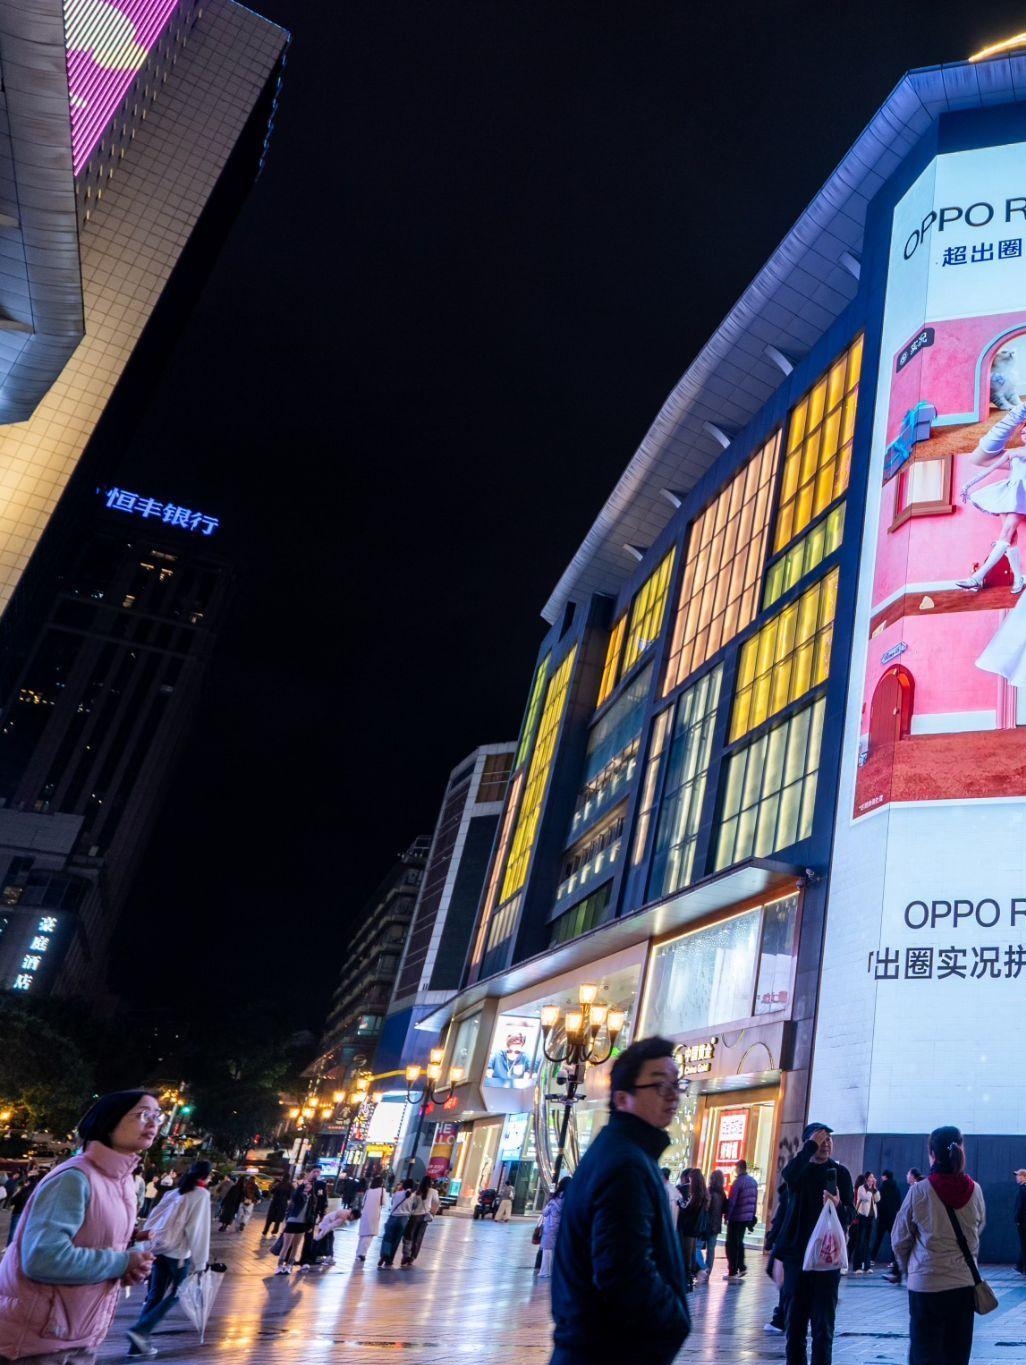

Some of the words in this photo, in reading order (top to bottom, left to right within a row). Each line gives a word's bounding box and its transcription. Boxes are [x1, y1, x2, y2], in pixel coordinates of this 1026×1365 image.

[903, 201, 994, 260] OPPO
[106, 487, 219, 535] 恒丰银行
[904, 898, 1000, 930] OPPO
